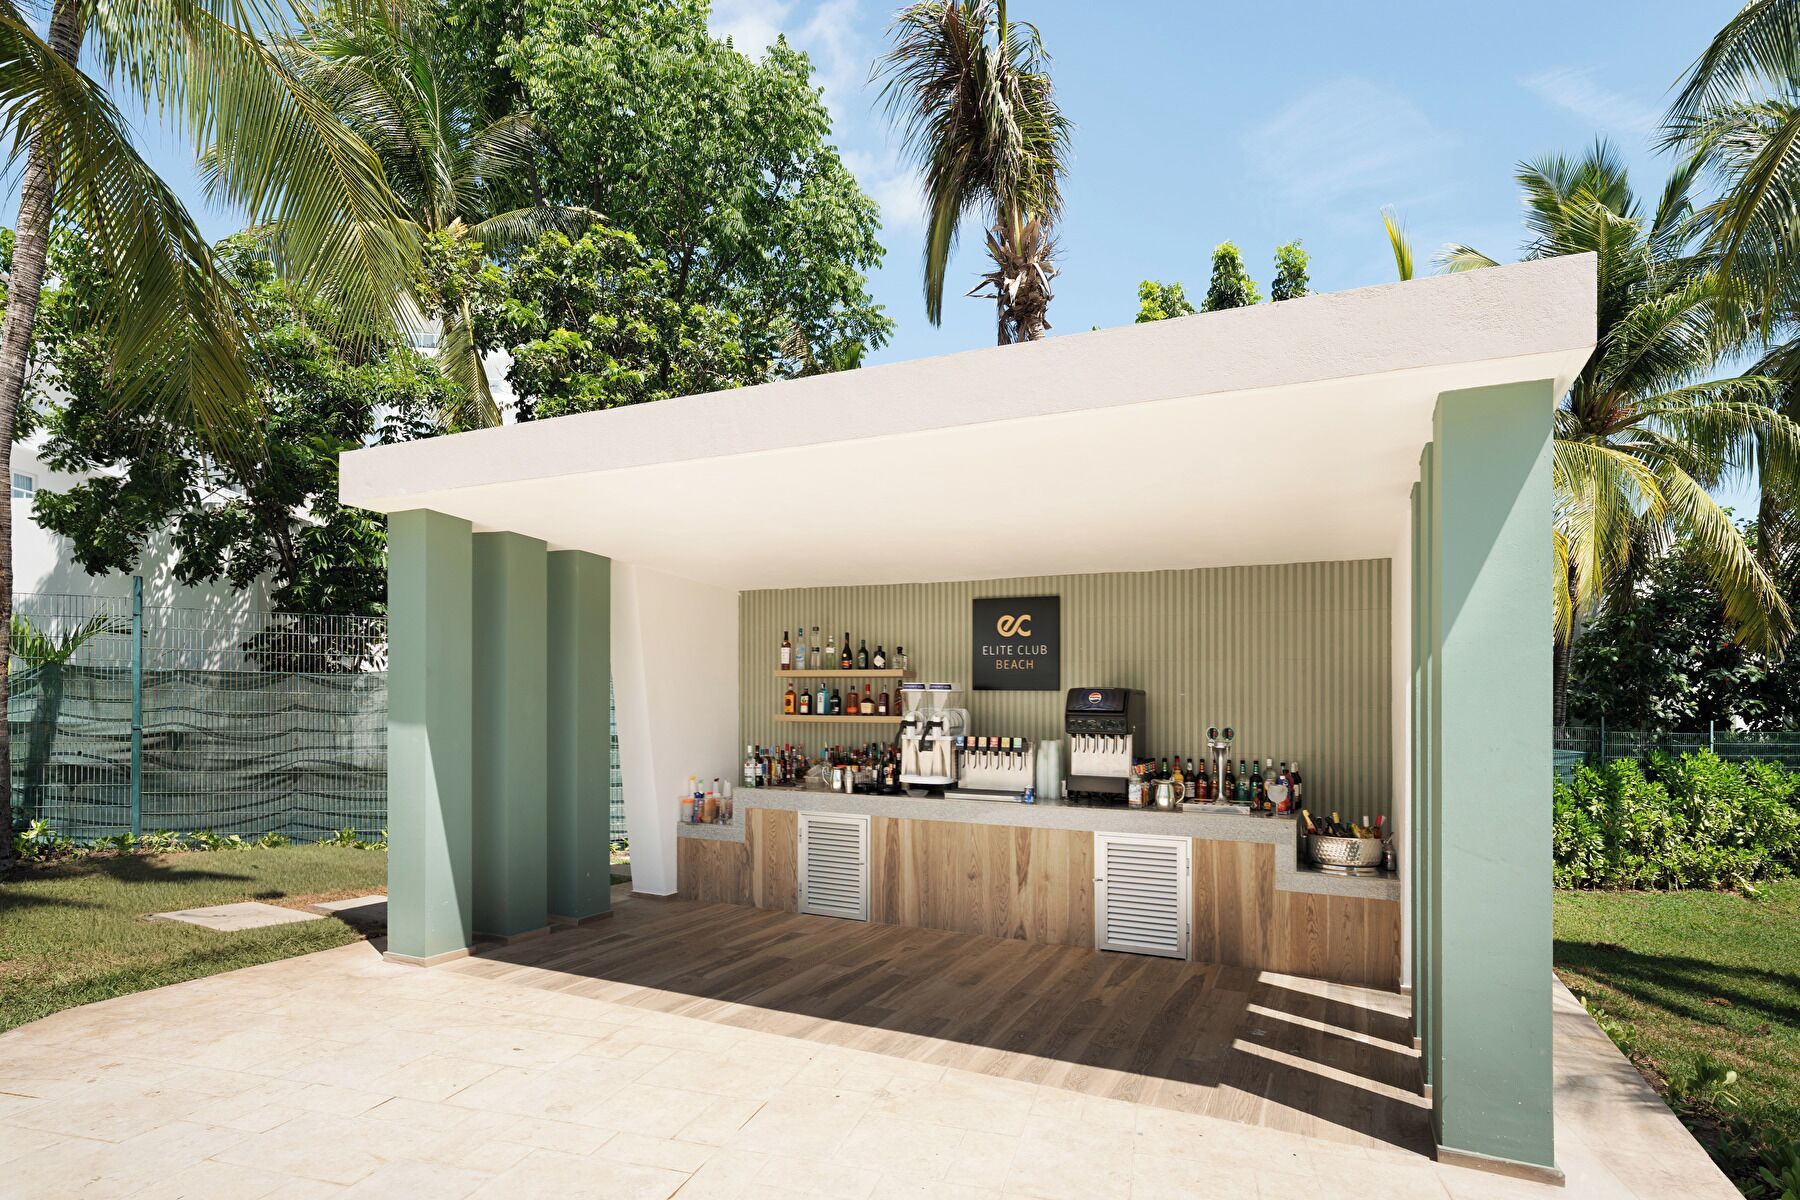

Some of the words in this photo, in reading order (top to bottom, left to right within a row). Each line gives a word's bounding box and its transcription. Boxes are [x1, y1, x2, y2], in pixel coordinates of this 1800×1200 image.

[982, 645, 1013, 656] ELITE
[1017, 644, 1048, 655] CLUB
[995, 659, 1034, 670] BEACH
